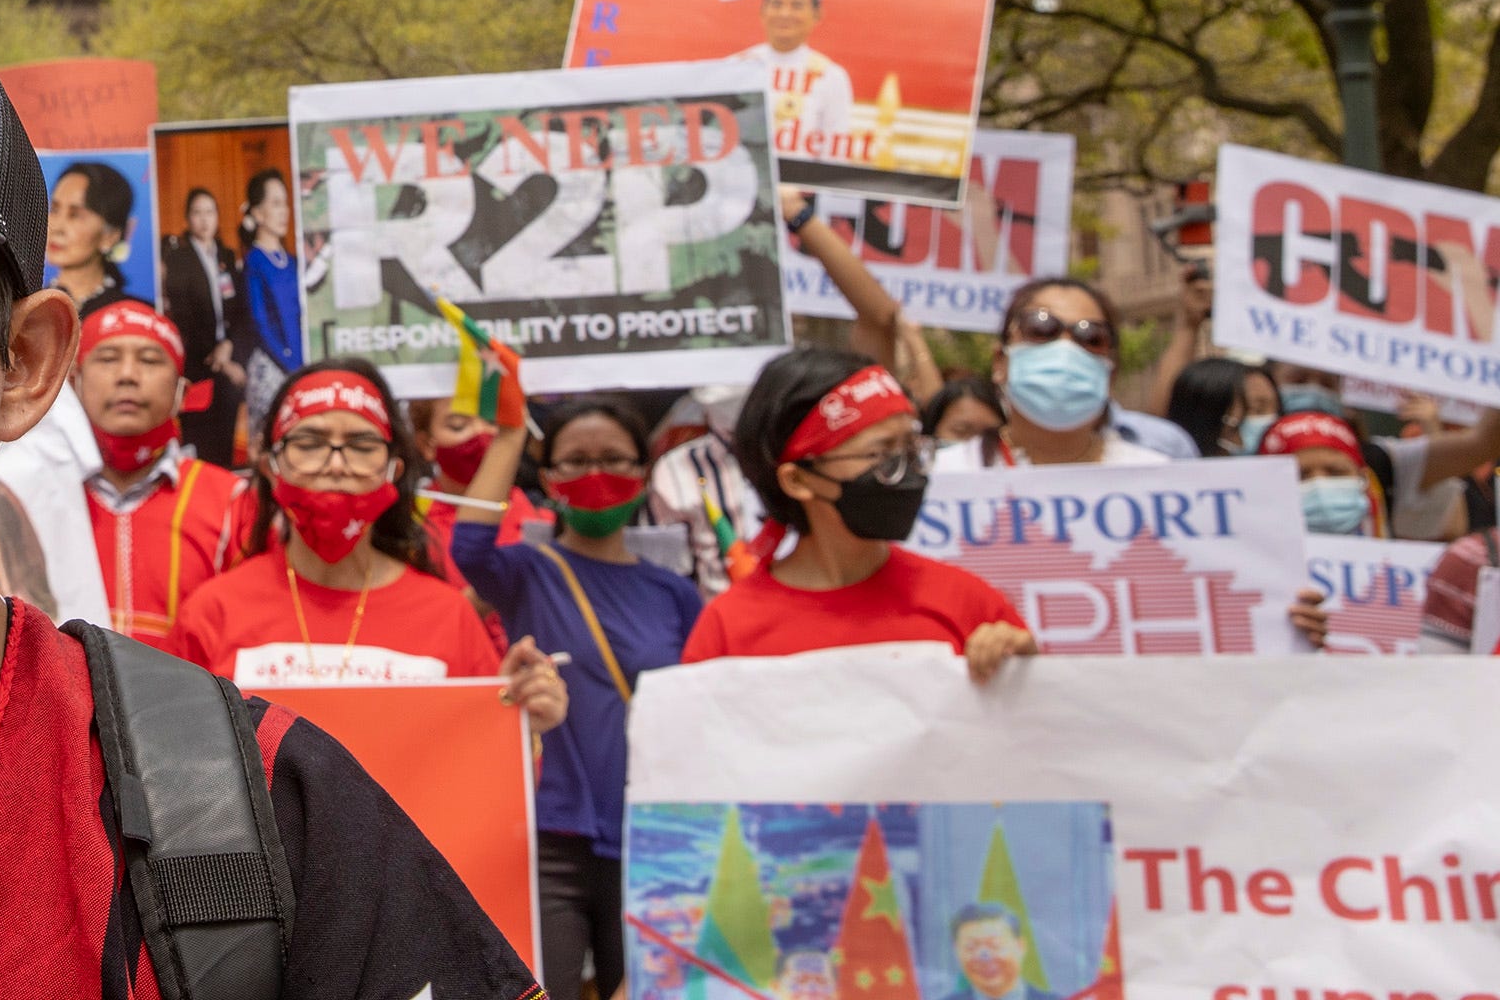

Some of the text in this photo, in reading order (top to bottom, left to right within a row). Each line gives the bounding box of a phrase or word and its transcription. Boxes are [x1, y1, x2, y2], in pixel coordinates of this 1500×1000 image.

[772, 66, 823, 94] ur
[331, 101, 741, 183] WE NEED
[774, 118, 876, 161] dent
[326, 122, 759, 310] R2P
[570, 314, 614, 340] TO
[618, 305, 758, 338] PROTECT
[1248, 304, 1500, 388] WE SUPPOR
[918, 489, 1244, 549] SUPPORT
[1123, 847, 1295, 916] The
